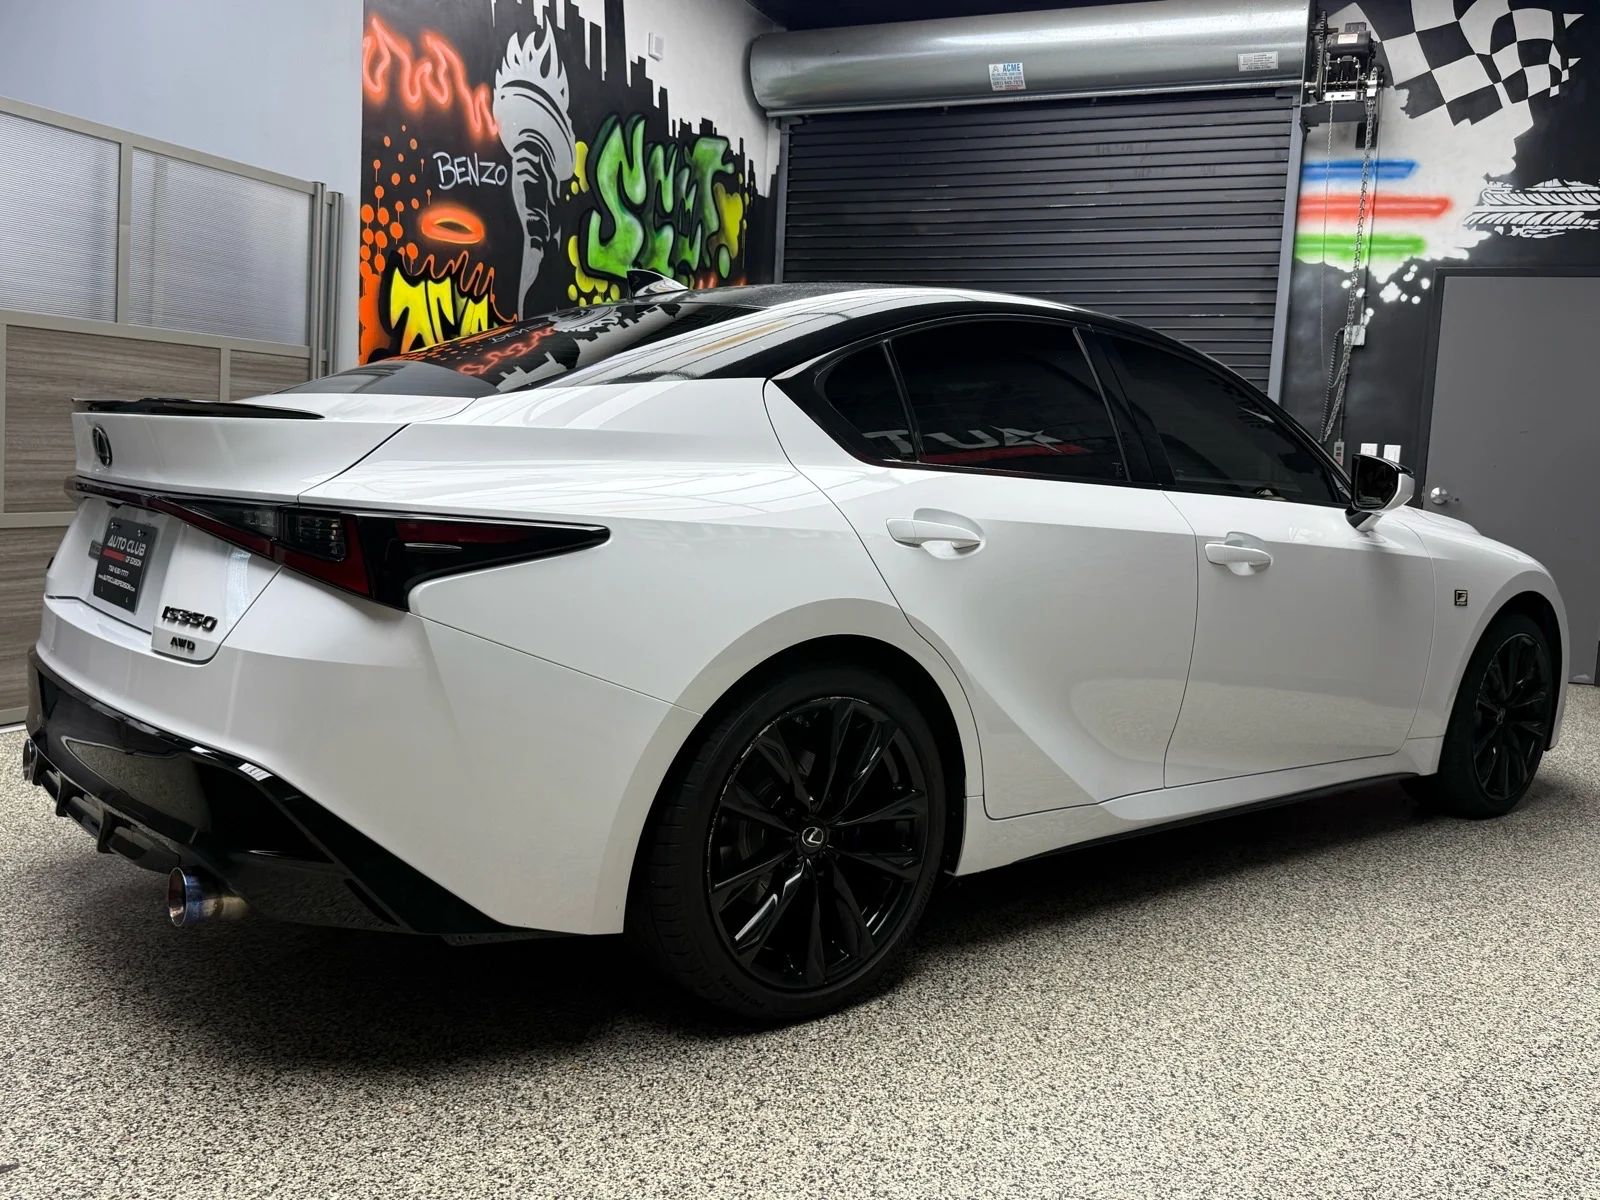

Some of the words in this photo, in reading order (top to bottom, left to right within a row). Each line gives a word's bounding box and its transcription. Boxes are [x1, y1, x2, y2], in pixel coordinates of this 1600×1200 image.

[1003, 63, 1021, 73] ACME
[432, 151, 508, 190] BENZO
[107, 534, 127, 550] AUTO
[127, 540, 146, 556] CLUB
[170, 636, 196, 651] AWD
